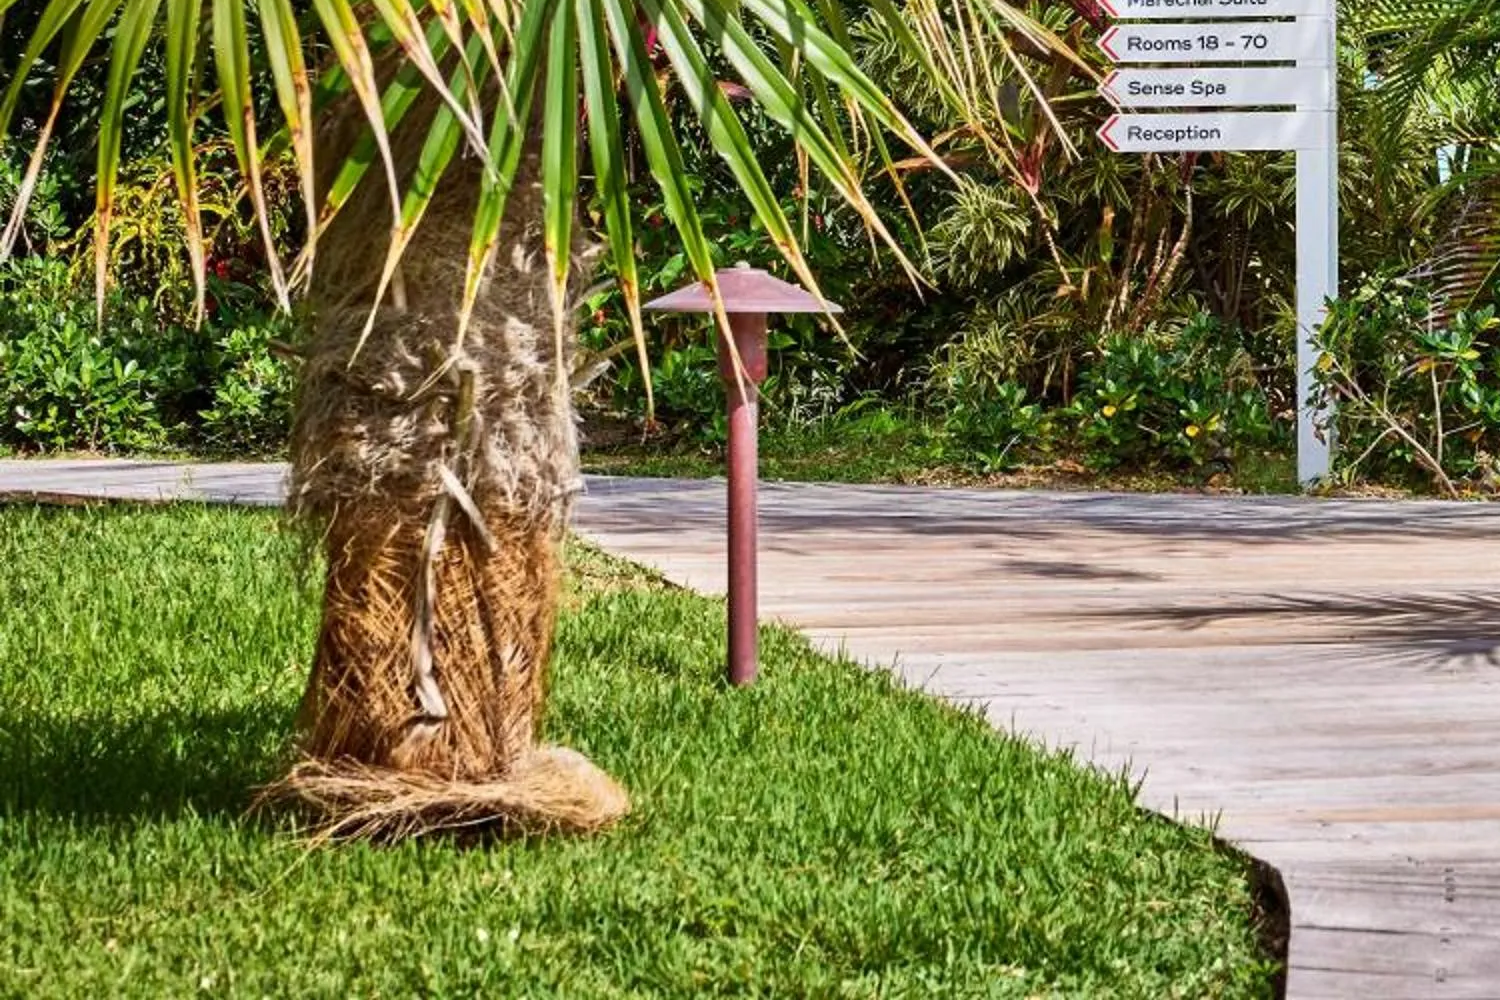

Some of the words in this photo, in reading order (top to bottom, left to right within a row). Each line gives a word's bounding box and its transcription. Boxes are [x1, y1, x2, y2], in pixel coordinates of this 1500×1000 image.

[1128, 37, 1192, 50] Rooms
[1197, 36, 1219, 50] 18
[1241, 34, 1267, 49] 70
[1128, 81, 1184, 95] Sense
[1191, 80, 1226, 97] Spa
[1128, 126, 1220, 142] Reception
